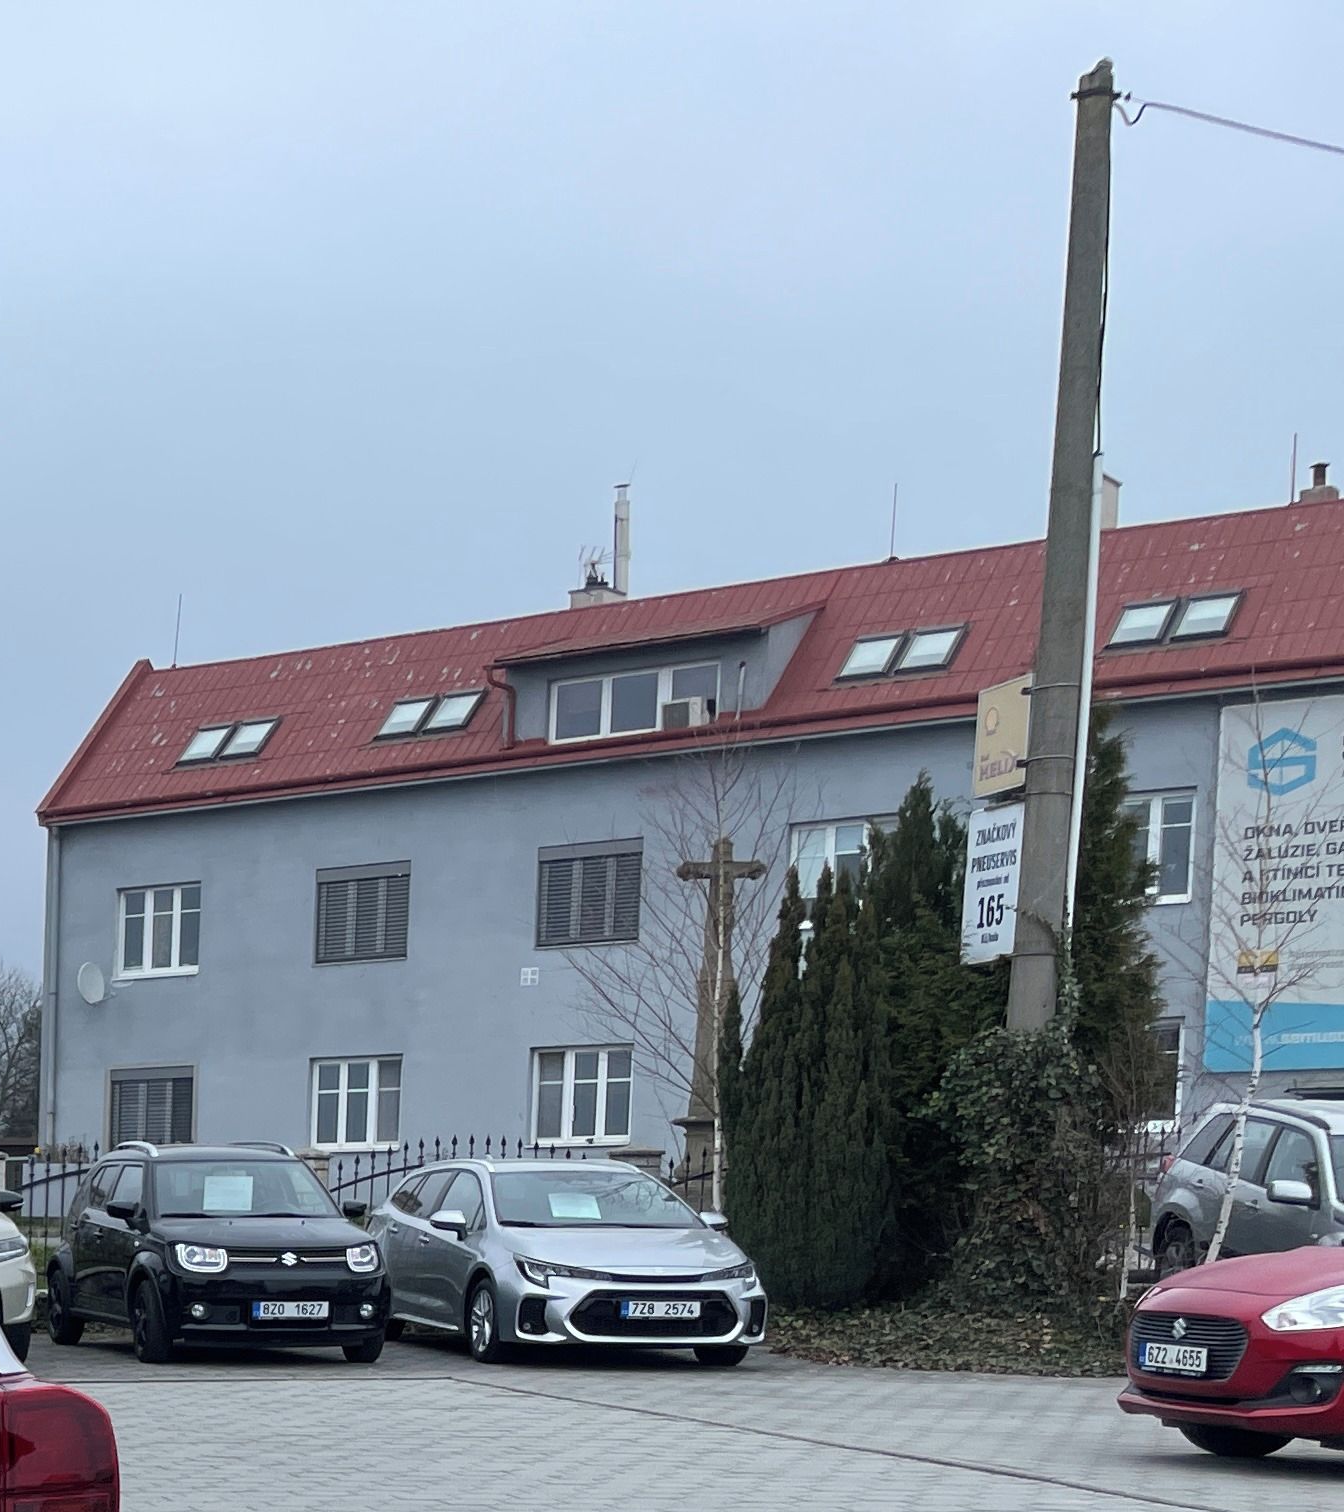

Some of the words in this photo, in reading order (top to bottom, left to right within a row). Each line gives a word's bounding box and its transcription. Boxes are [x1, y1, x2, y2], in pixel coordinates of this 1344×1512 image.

[975, 818, 1017, 847] ZNAČKOVÝ
[970, 849, 1017, 873] PNEUSERVIS
[1241, 870, 1254, 884] A
[976, 893, 1005, 929] 165
[1240, 908, 1318, 927] PERGOLY
[262, 1303, 285, 1315] 8Z0
[294, 1303, 323, 1316] 1627
[632, 1303, 655, 1315] 7Z8
[664, 1303, 694, 1316] 2574
[1148, 1346, 1167, 1364] 6Z2
[1175, 1348, 1203, 1368] 4655
